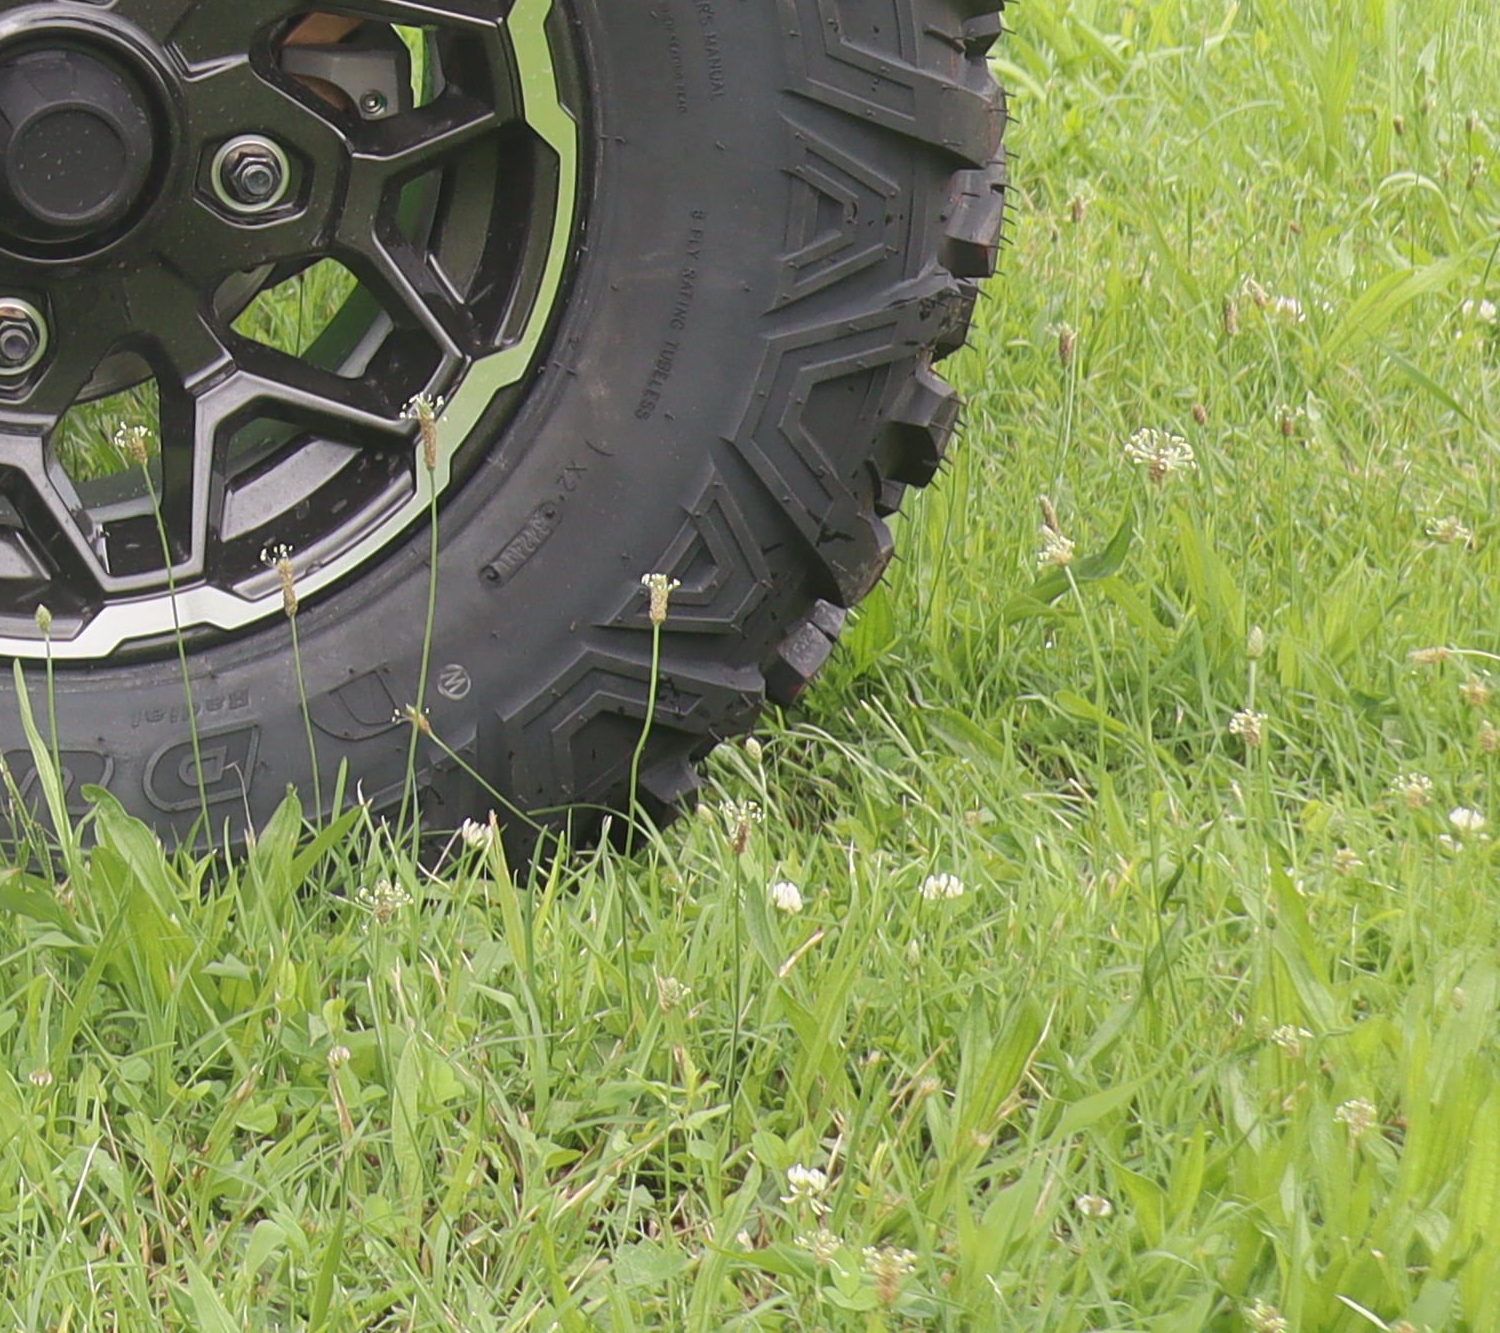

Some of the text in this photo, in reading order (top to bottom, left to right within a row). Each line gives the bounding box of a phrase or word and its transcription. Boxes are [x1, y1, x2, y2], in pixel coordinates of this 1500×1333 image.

[686, 227, 704, 261] PLY
[669, 266, 698, 331] RATING
[635, 339, 680, 421] TUBELESS
[128, 686, 251, 729] Radial
